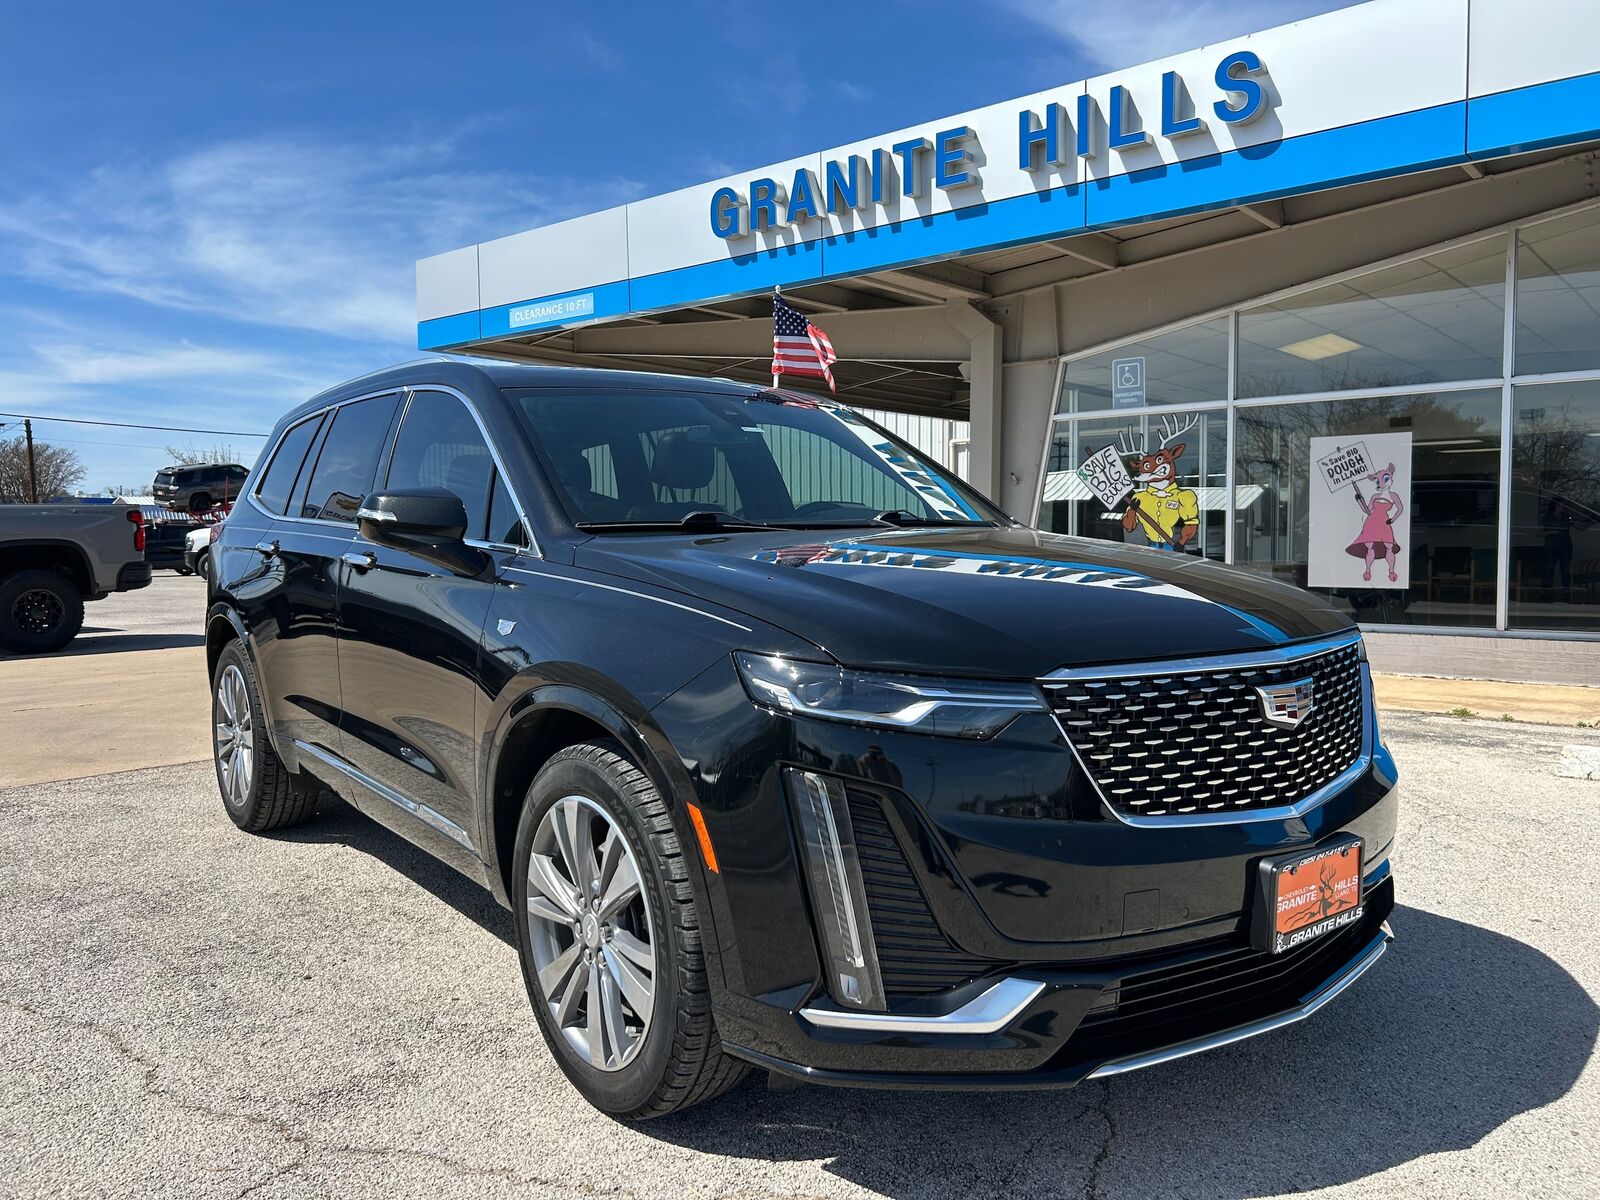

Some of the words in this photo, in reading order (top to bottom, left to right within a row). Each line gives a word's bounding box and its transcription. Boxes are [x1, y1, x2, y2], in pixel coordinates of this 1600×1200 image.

[710, 125, 977, 241] GRANITE
[1018, 50, 1267, 172] HILLS
[514, 303, 563, 321] CLEARANCE
[565, 302, 575, 312] 10
[576, 298, 587, 310] FT
[1084, 447, 1117, 477] SAVE
[1326, 454, 1365, 479] DOUGH
[1329, 455, 1346, 465] Save
[1346, 448, 1358, 458] BIG
[1090, 463, 1121, 492] BIG
[1341, 464, 1368, 482] LLANO!
[1101, 474, 1132, 505] BUCKS
[609, 799, 668, 980] MASTERCRAFT
[1277, 890, 1318, 913] GRANITE
[1333, 874, 1359, 893] HILLS
[1283, 886, 1309, 900] CHEVROLET
[1289, 918, 1335, 946] GRANITE
[1335, 906, 1363, 927] HILLS
